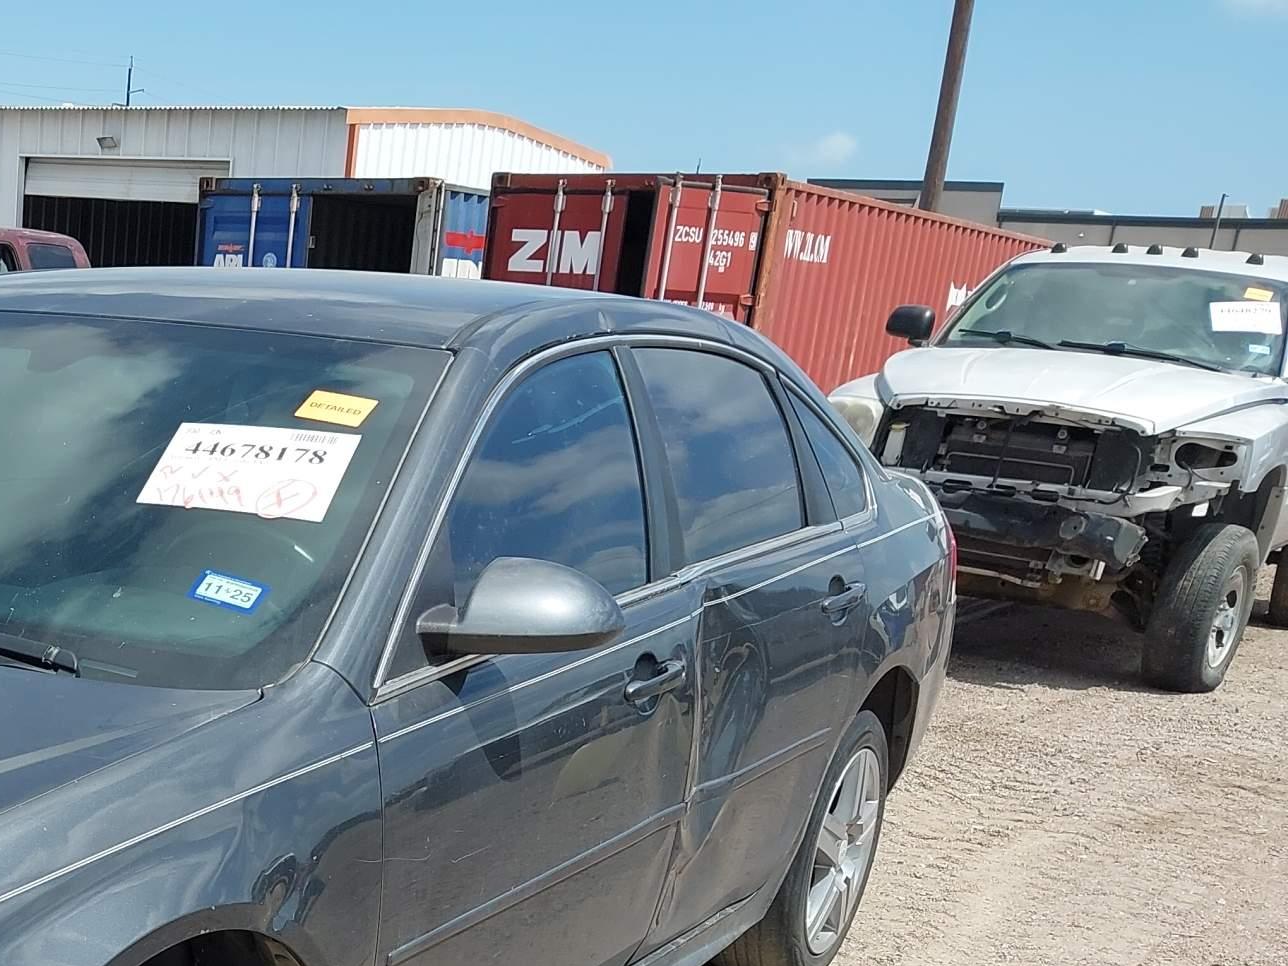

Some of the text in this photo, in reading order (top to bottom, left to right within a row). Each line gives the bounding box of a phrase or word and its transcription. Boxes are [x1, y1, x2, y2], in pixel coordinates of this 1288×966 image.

[675, 226, 703, 243] ZCSU
[712, 229, 746, 247] 255496
[507, 229, 601, 275] ZIM
[708, 250, 732, 267] 42G1
[309, 402, 362, 416] DETAILED
[185, 440, 327, 465] 44678178
